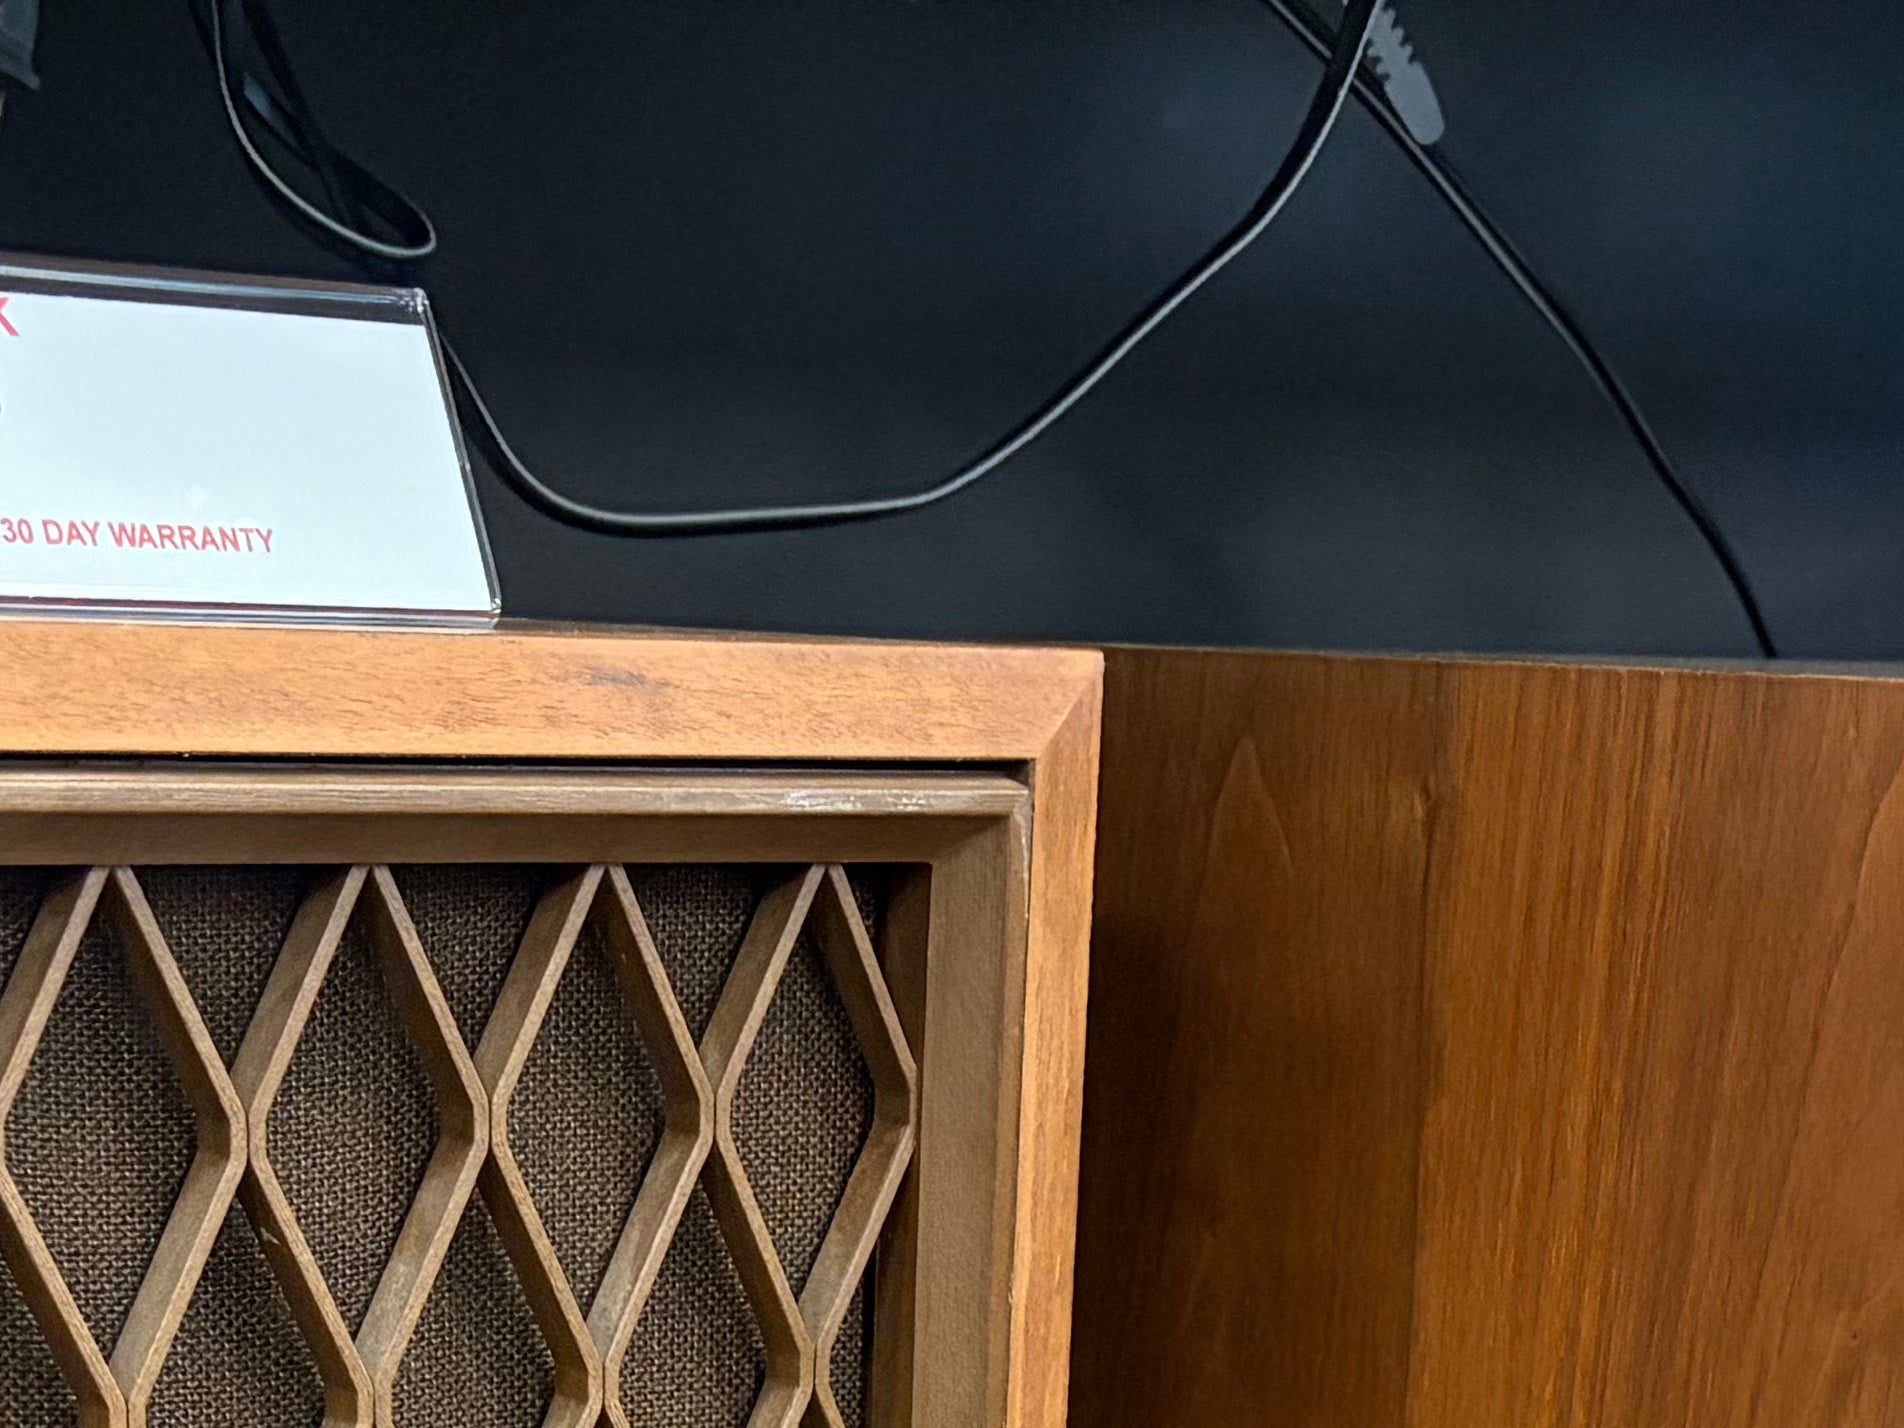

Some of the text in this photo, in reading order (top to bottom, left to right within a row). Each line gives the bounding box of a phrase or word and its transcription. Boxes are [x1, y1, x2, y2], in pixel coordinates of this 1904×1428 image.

[1, 518, 34, 545] 30
[43, 519, 101, 547] DAY
[107, 521, 274, 554] WARRANTY
